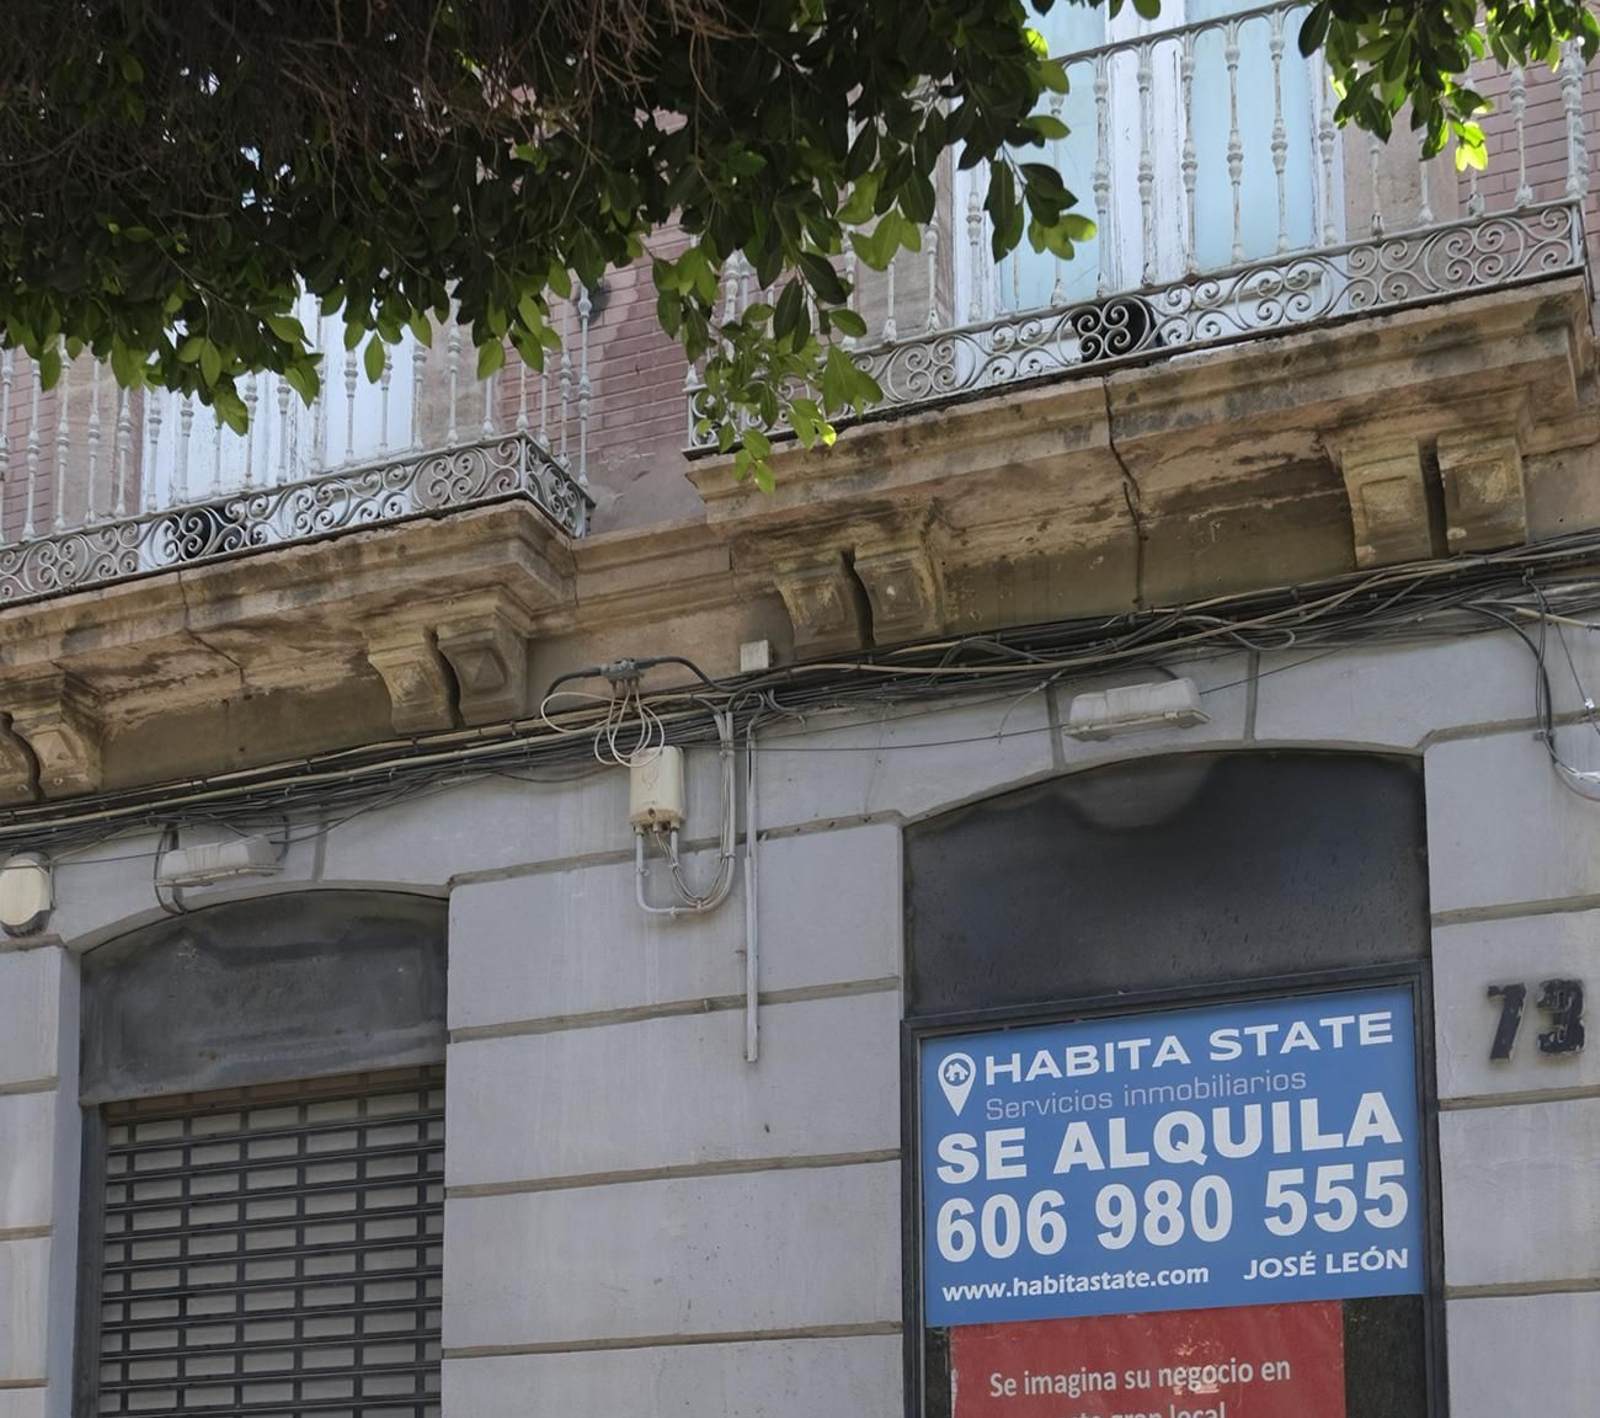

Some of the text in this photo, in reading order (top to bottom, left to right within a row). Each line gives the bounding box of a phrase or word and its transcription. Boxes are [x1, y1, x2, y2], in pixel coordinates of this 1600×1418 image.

[985, 1011, 1393, 1086] HABITA STATE
[1486, 978, 1585, 1061] 73
[986, 1069, 1307, 1121] Servicios inmobiliarios
[936, 1091, 1403, 1184] SE ALQUILA
[936, 1159, 1409, 1263] 606 980 555
[942, 1264, 1210, 1302] www.habitastate.com
[1244, 1245, 1409, 1281] JOSÉ LEÓN
[990, 1357, 1291, 1399] Se imagina su negocio en
